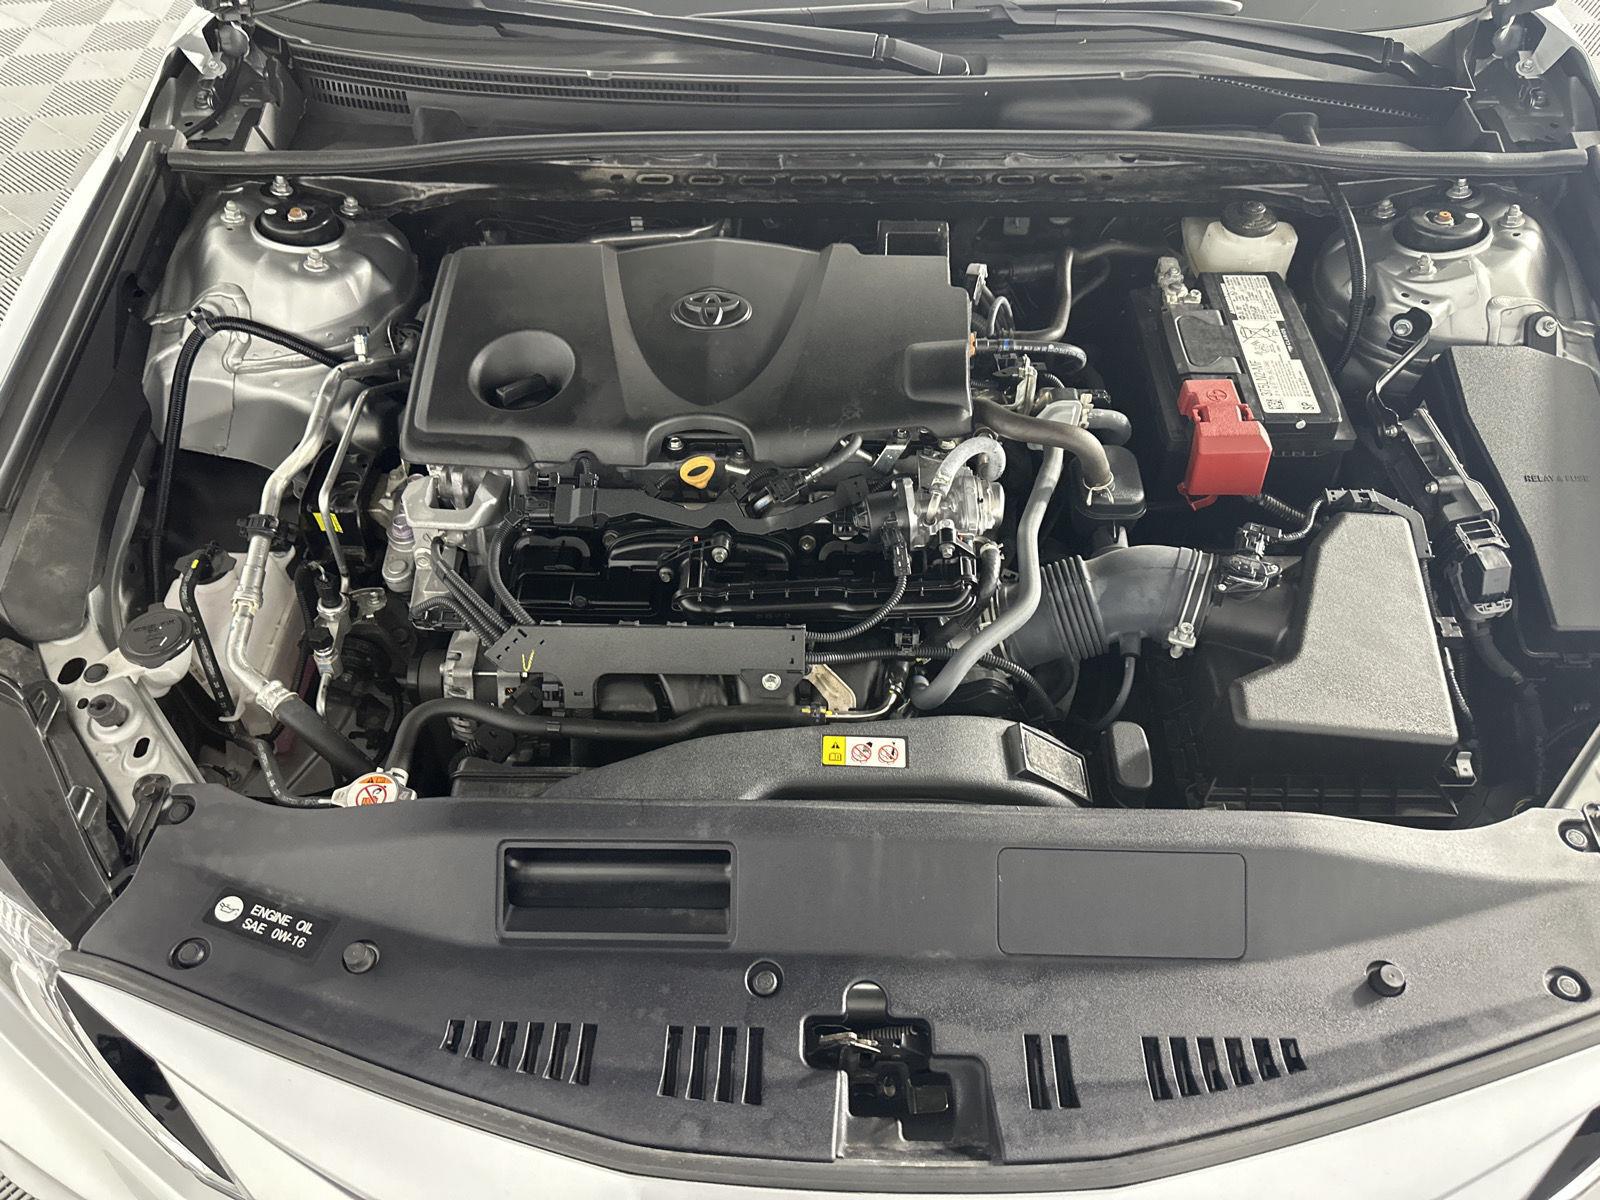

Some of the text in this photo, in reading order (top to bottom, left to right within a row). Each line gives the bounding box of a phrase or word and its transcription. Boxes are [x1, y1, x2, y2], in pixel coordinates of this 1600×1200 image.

[1524, 475, 1554, 483] RELAY
[241, 918, 307, 949] SAE 0W-16
[250, 904, 313, 935] ENGINE OIL
